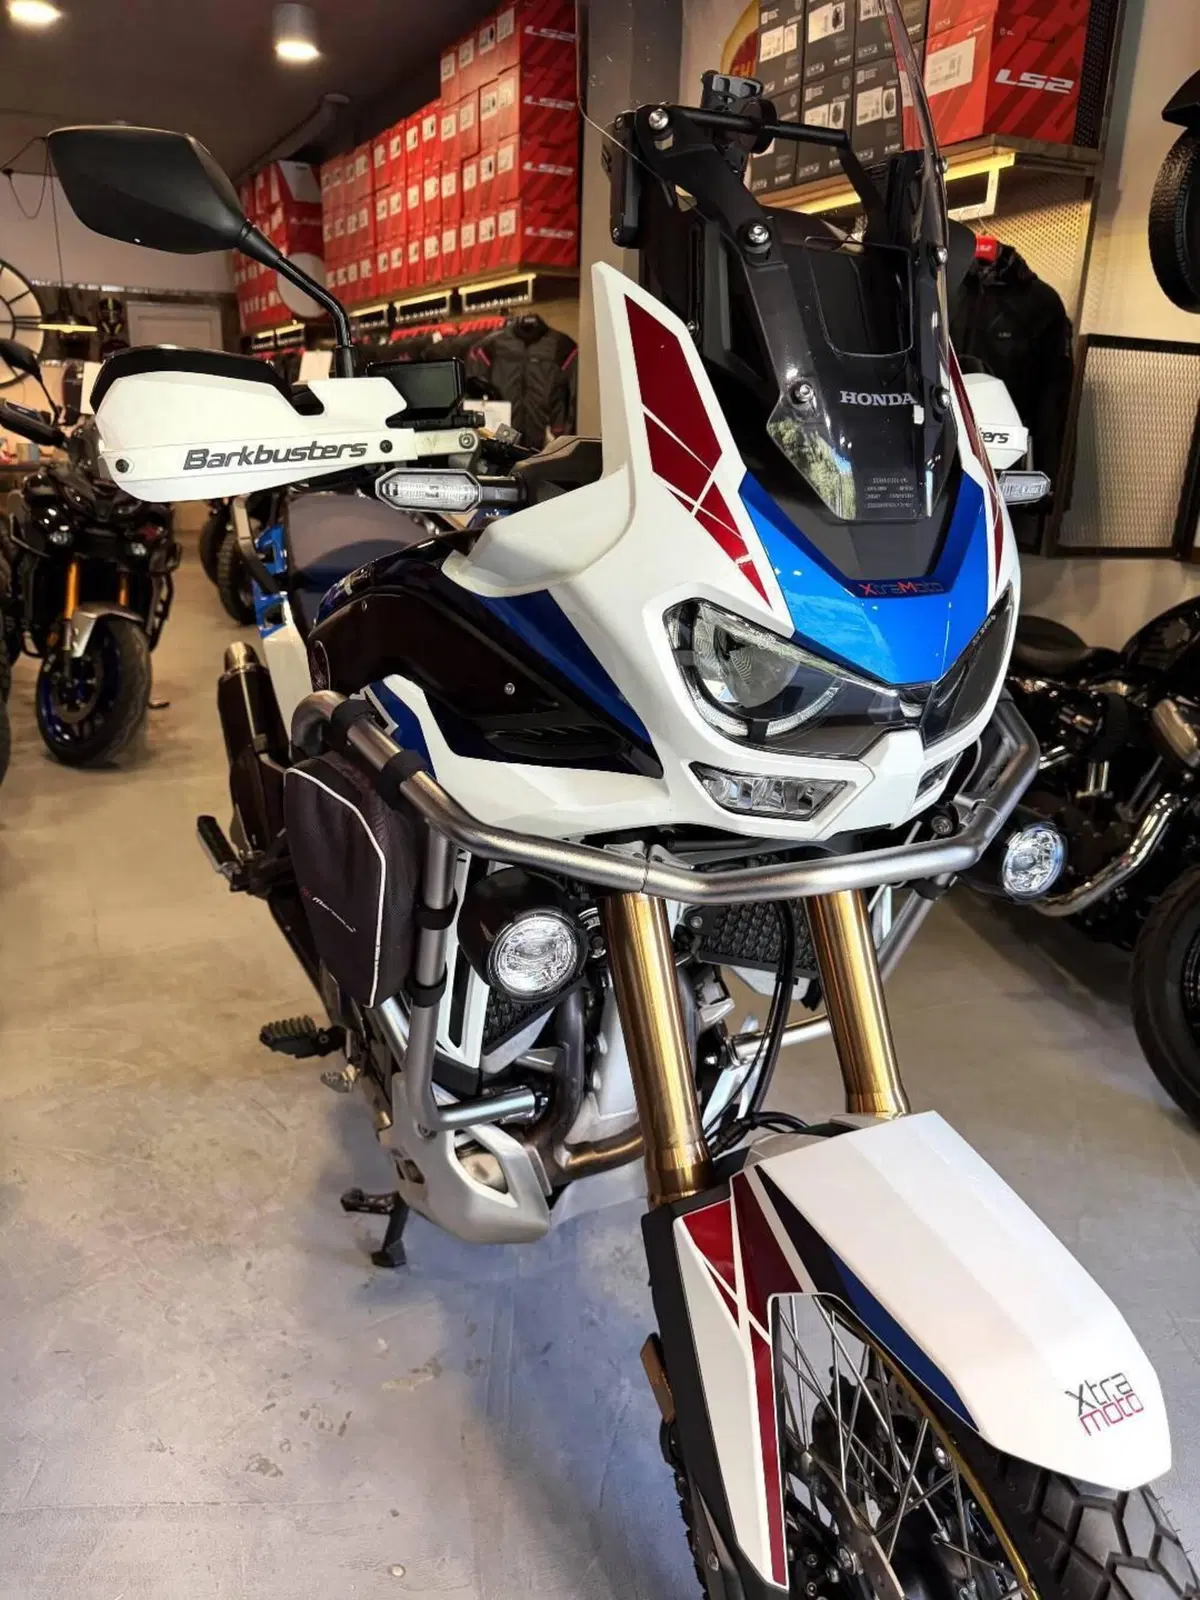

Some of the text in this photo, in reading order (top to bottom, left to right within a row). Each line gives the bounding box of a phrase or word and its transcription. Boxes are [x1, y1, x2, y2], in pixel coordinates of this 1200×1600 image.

[995, 68, 1075, 95] LS2
[840, 390, 918, 406] HONDA
[183, 440, 368, 470] Barkbusters
[1064, 1372, 1133, 1417] Xtra
[1080, 1393, 1144, 1436] moto
